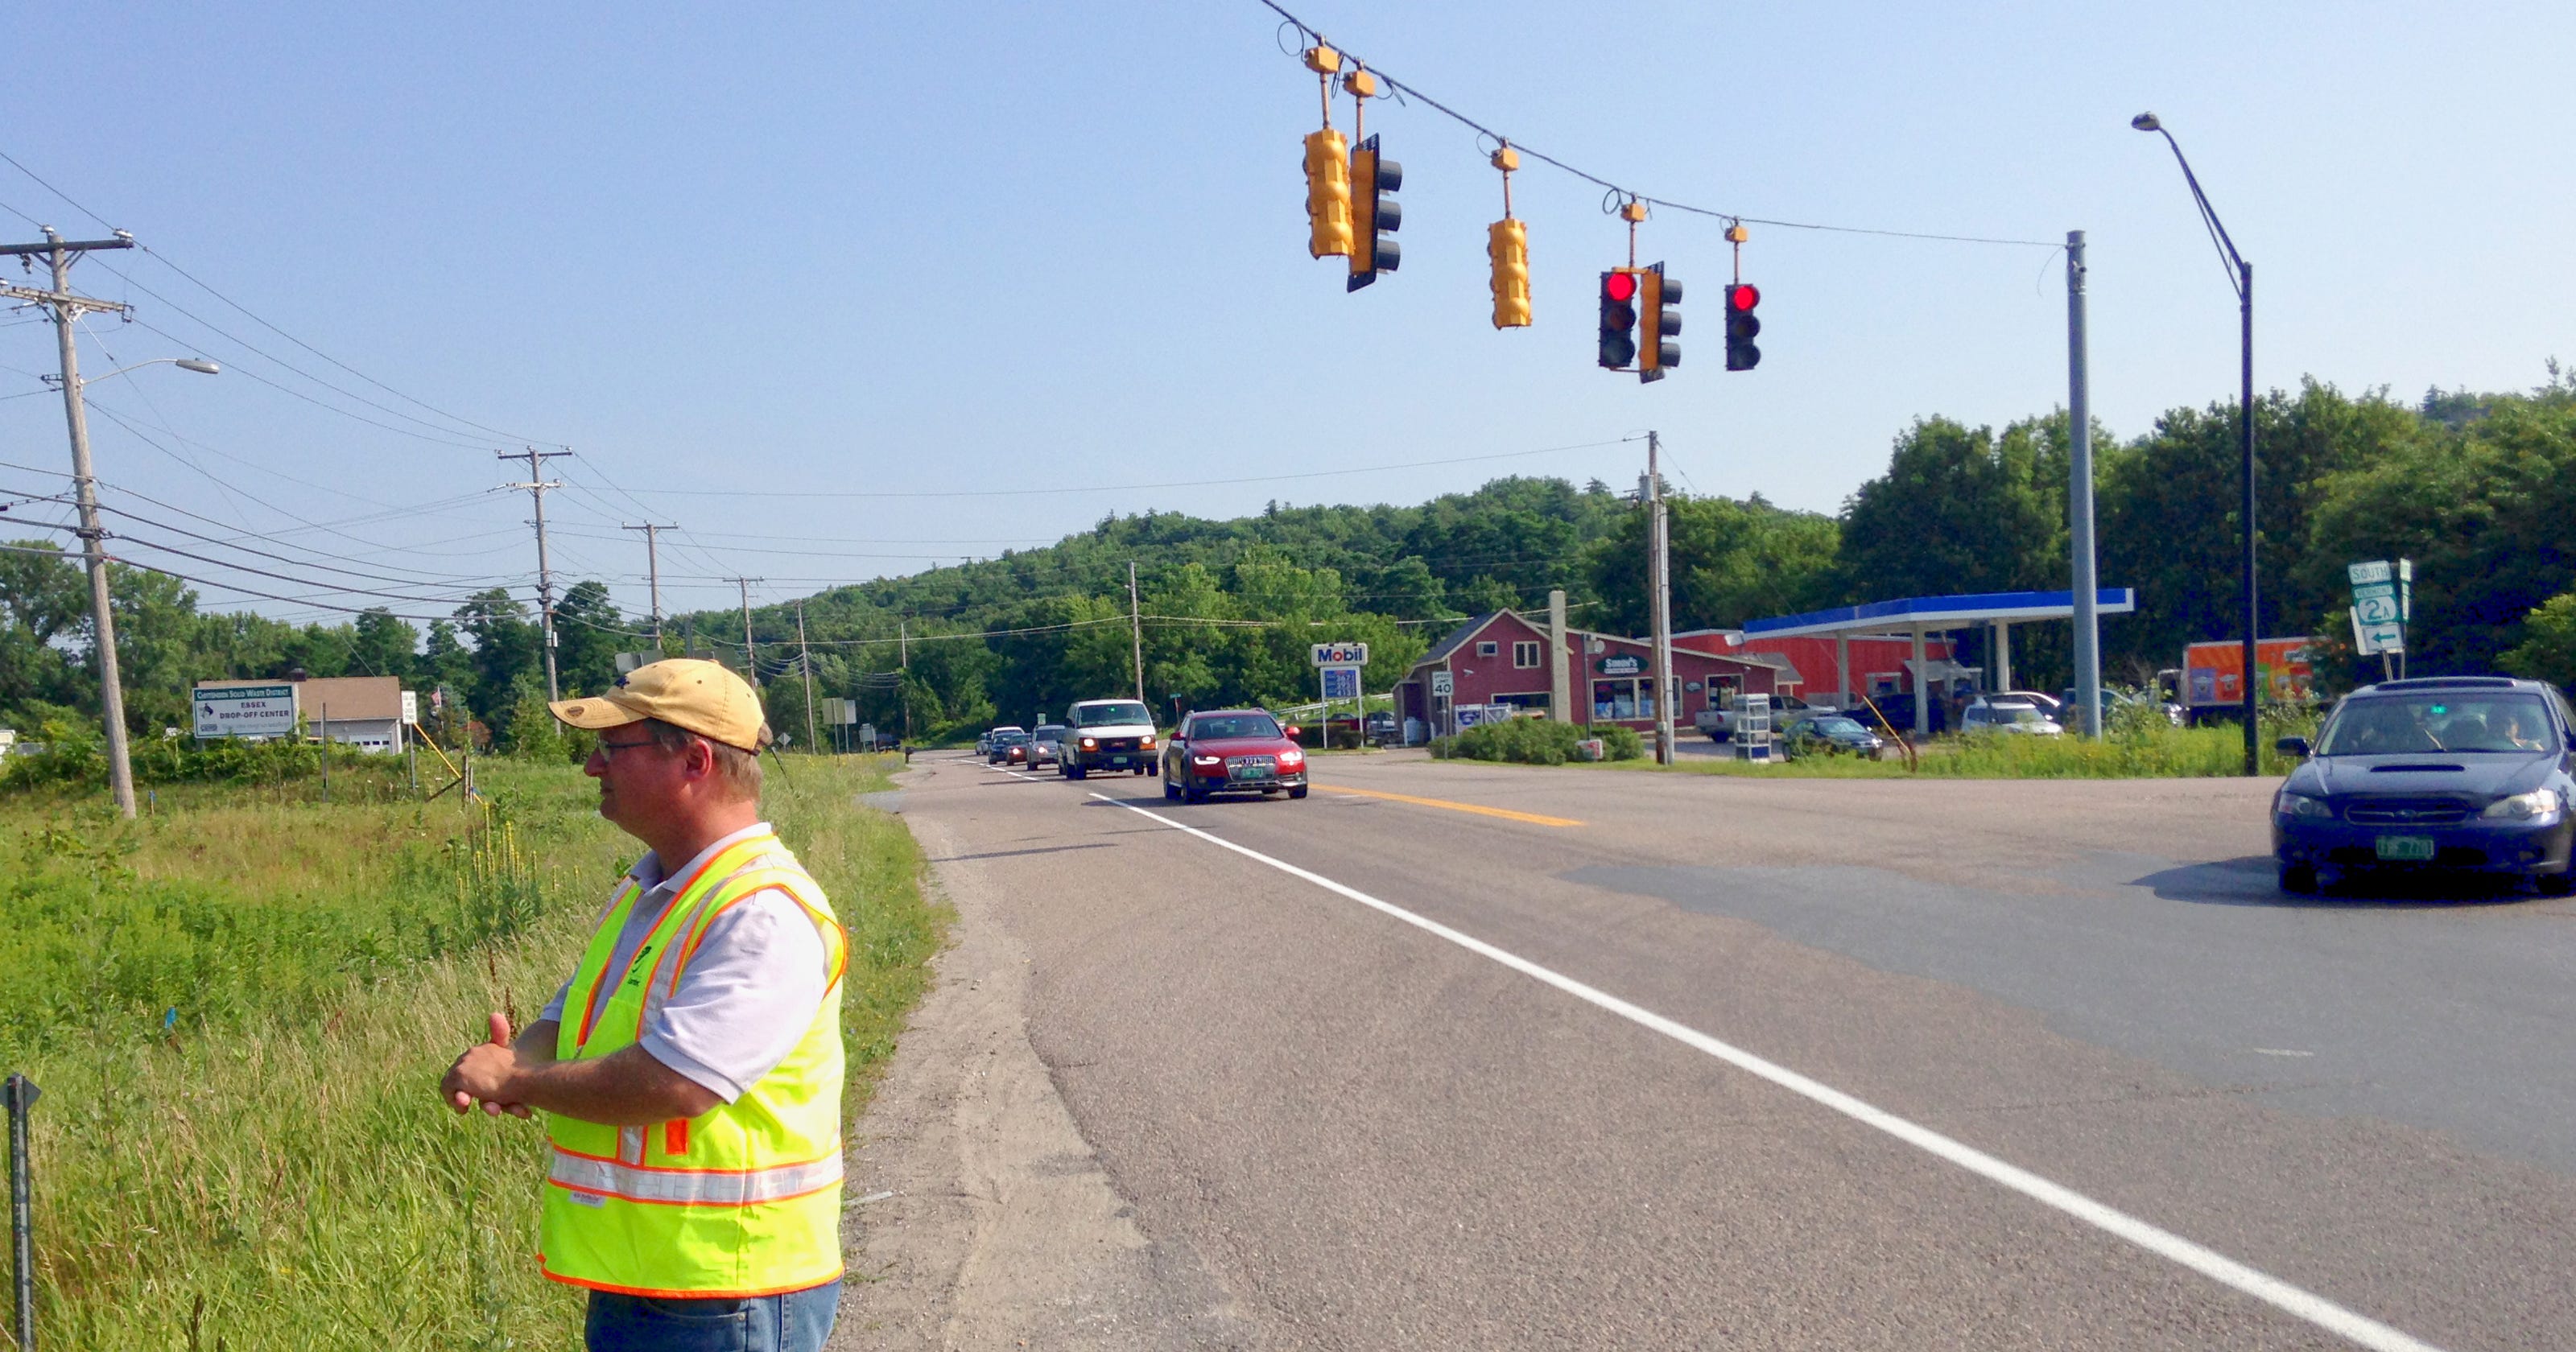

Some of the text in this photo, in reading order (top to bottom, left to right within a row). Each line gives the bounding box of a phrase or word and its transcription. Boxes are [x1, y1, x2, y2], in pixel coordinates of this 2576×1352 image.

[2352, 566, 2388, 580] SOUTH
[2365, 599, 2390, 619] 2A
[1318, 648, 1362, 662] Mobil
[1435, 684, 1451, 693] 40
[220, 710, 289, 719] DROP-OFF CENTER
